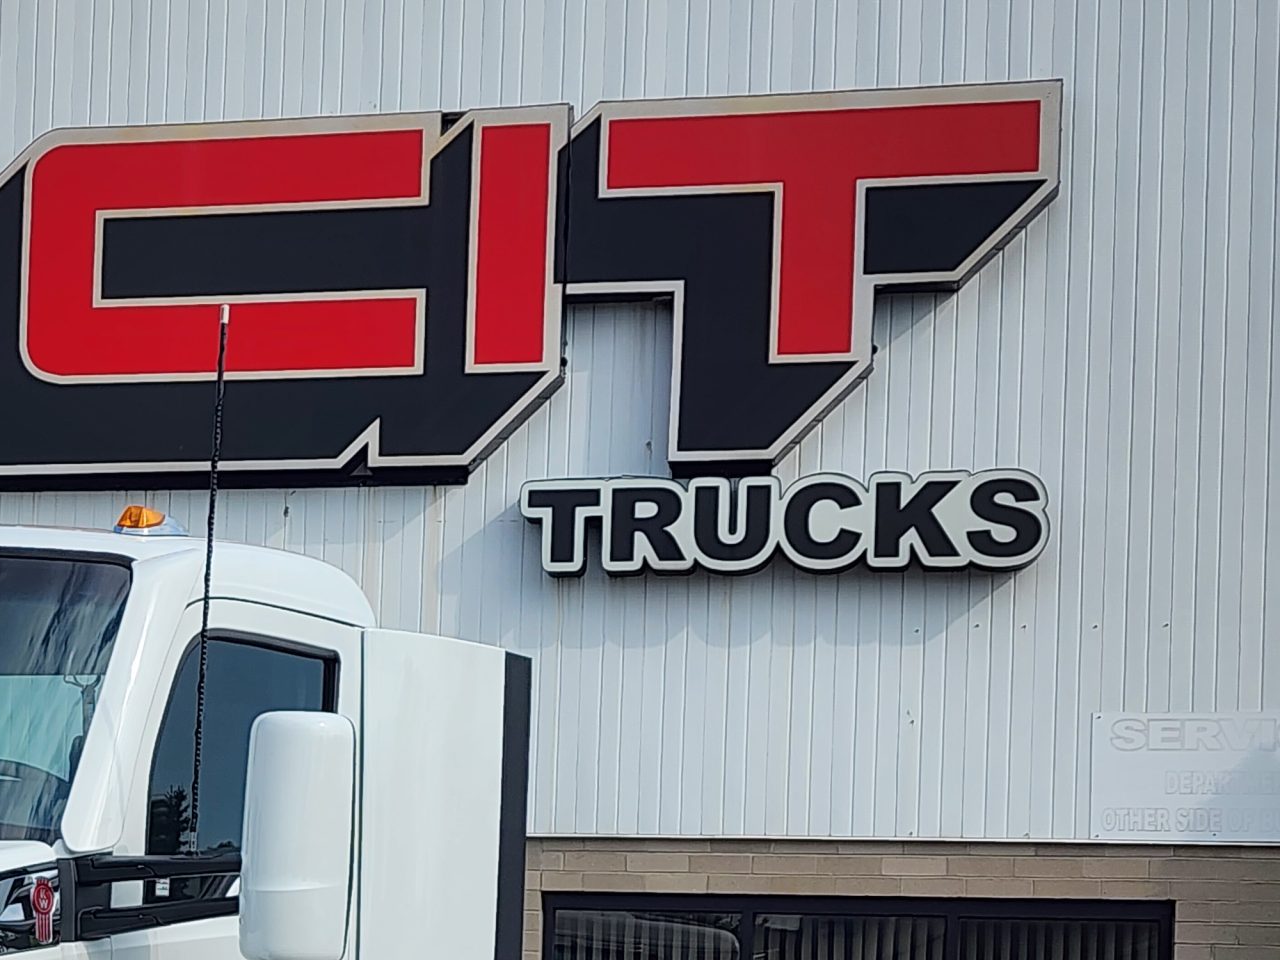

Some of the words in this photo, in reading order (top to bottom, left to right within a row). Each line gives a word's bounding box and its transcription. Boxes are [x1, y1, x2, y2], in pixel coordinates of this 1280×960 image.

[17, 88, 1050, 386] CIT
[526, 477, 1044, 564] TRUCKS
[1110, 717, 1280, 752] SERVI
[1101, 807, 1171, 832] OTHER
[1175, 807, 1223, 832] SIDE
